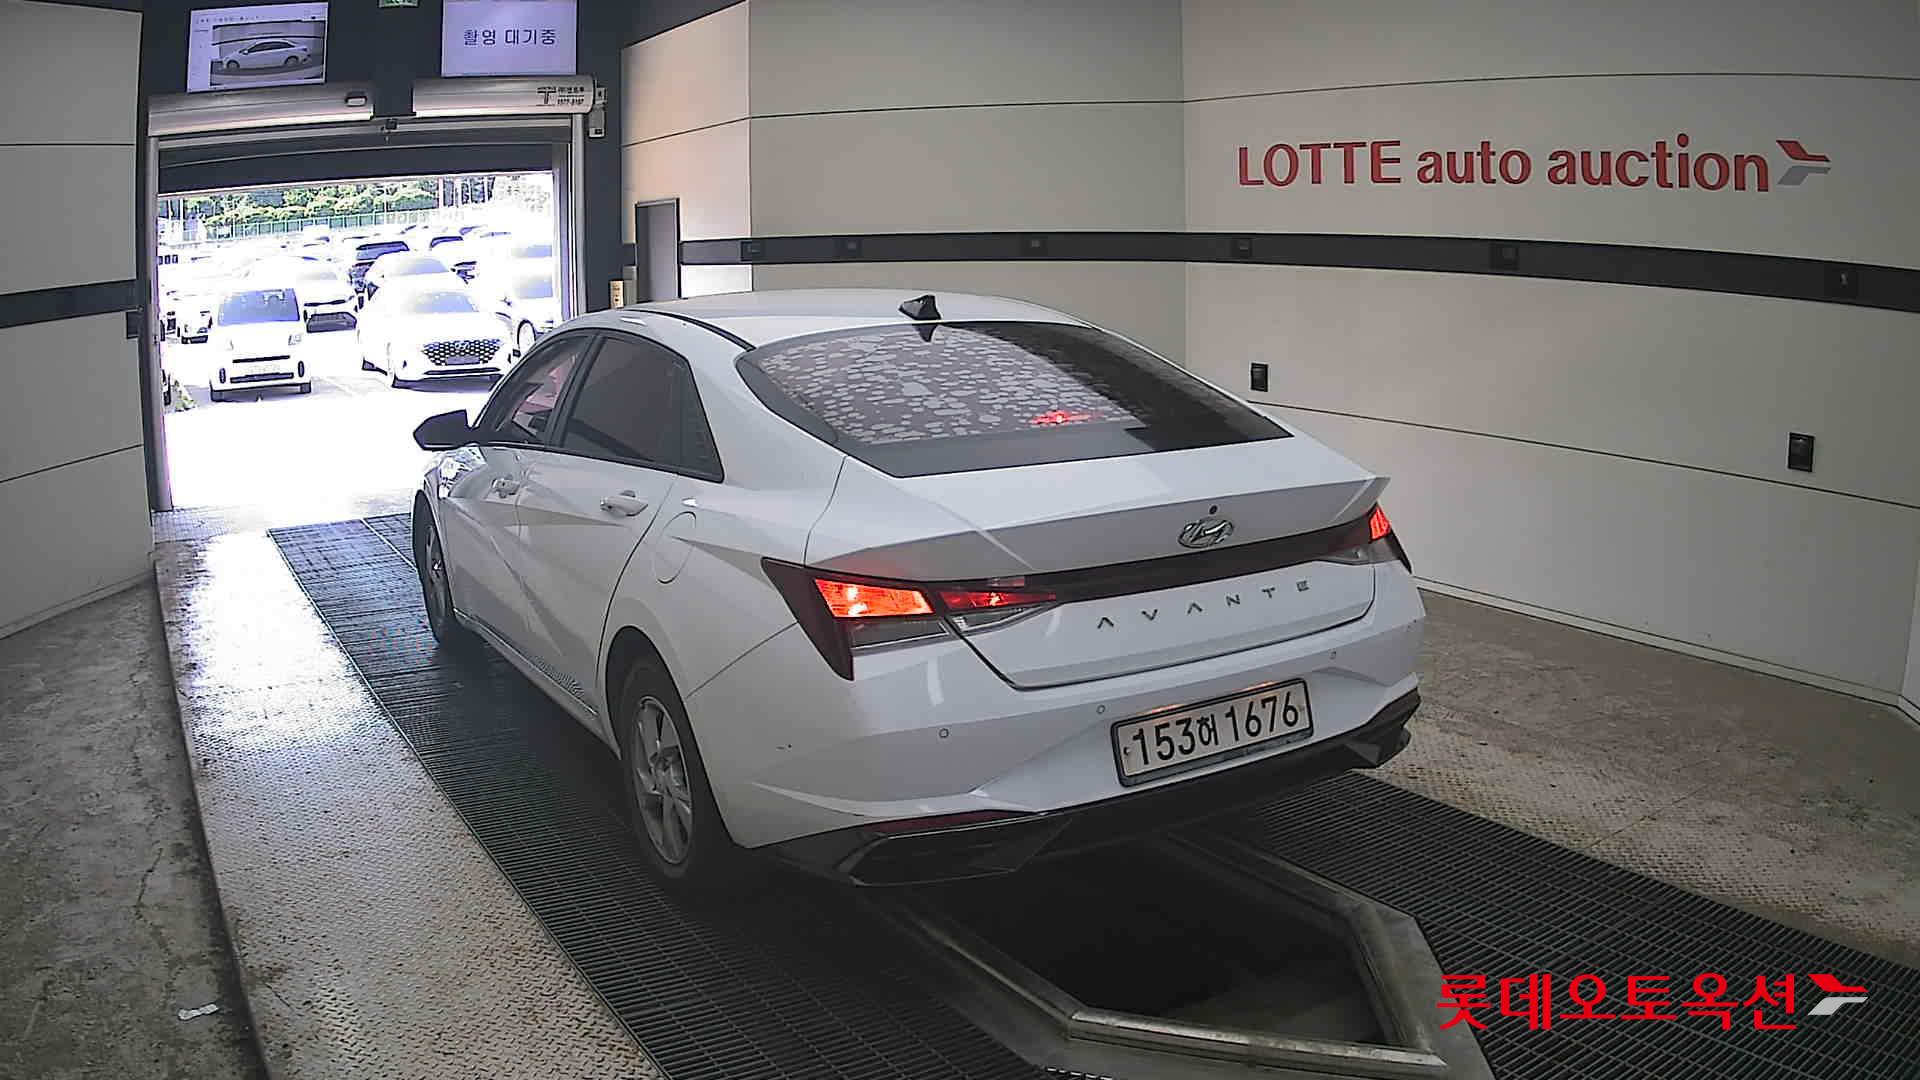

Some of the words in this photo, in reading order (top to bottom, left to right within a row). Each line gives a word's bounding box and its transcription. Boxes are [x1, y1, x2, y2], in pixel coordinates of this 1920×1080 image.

[504, 28, 556, 46] 대기중
[1238, 140, 1401, 187] LOTTE
[1416, 140, 1532, 185] auto
[1547, 133, 1770, 193] auction
[1096, 579, 1310, 630] AVANTE
[1132, 713, 1219, 766] 153허
[1225, 691, 1300, 742] 1676
